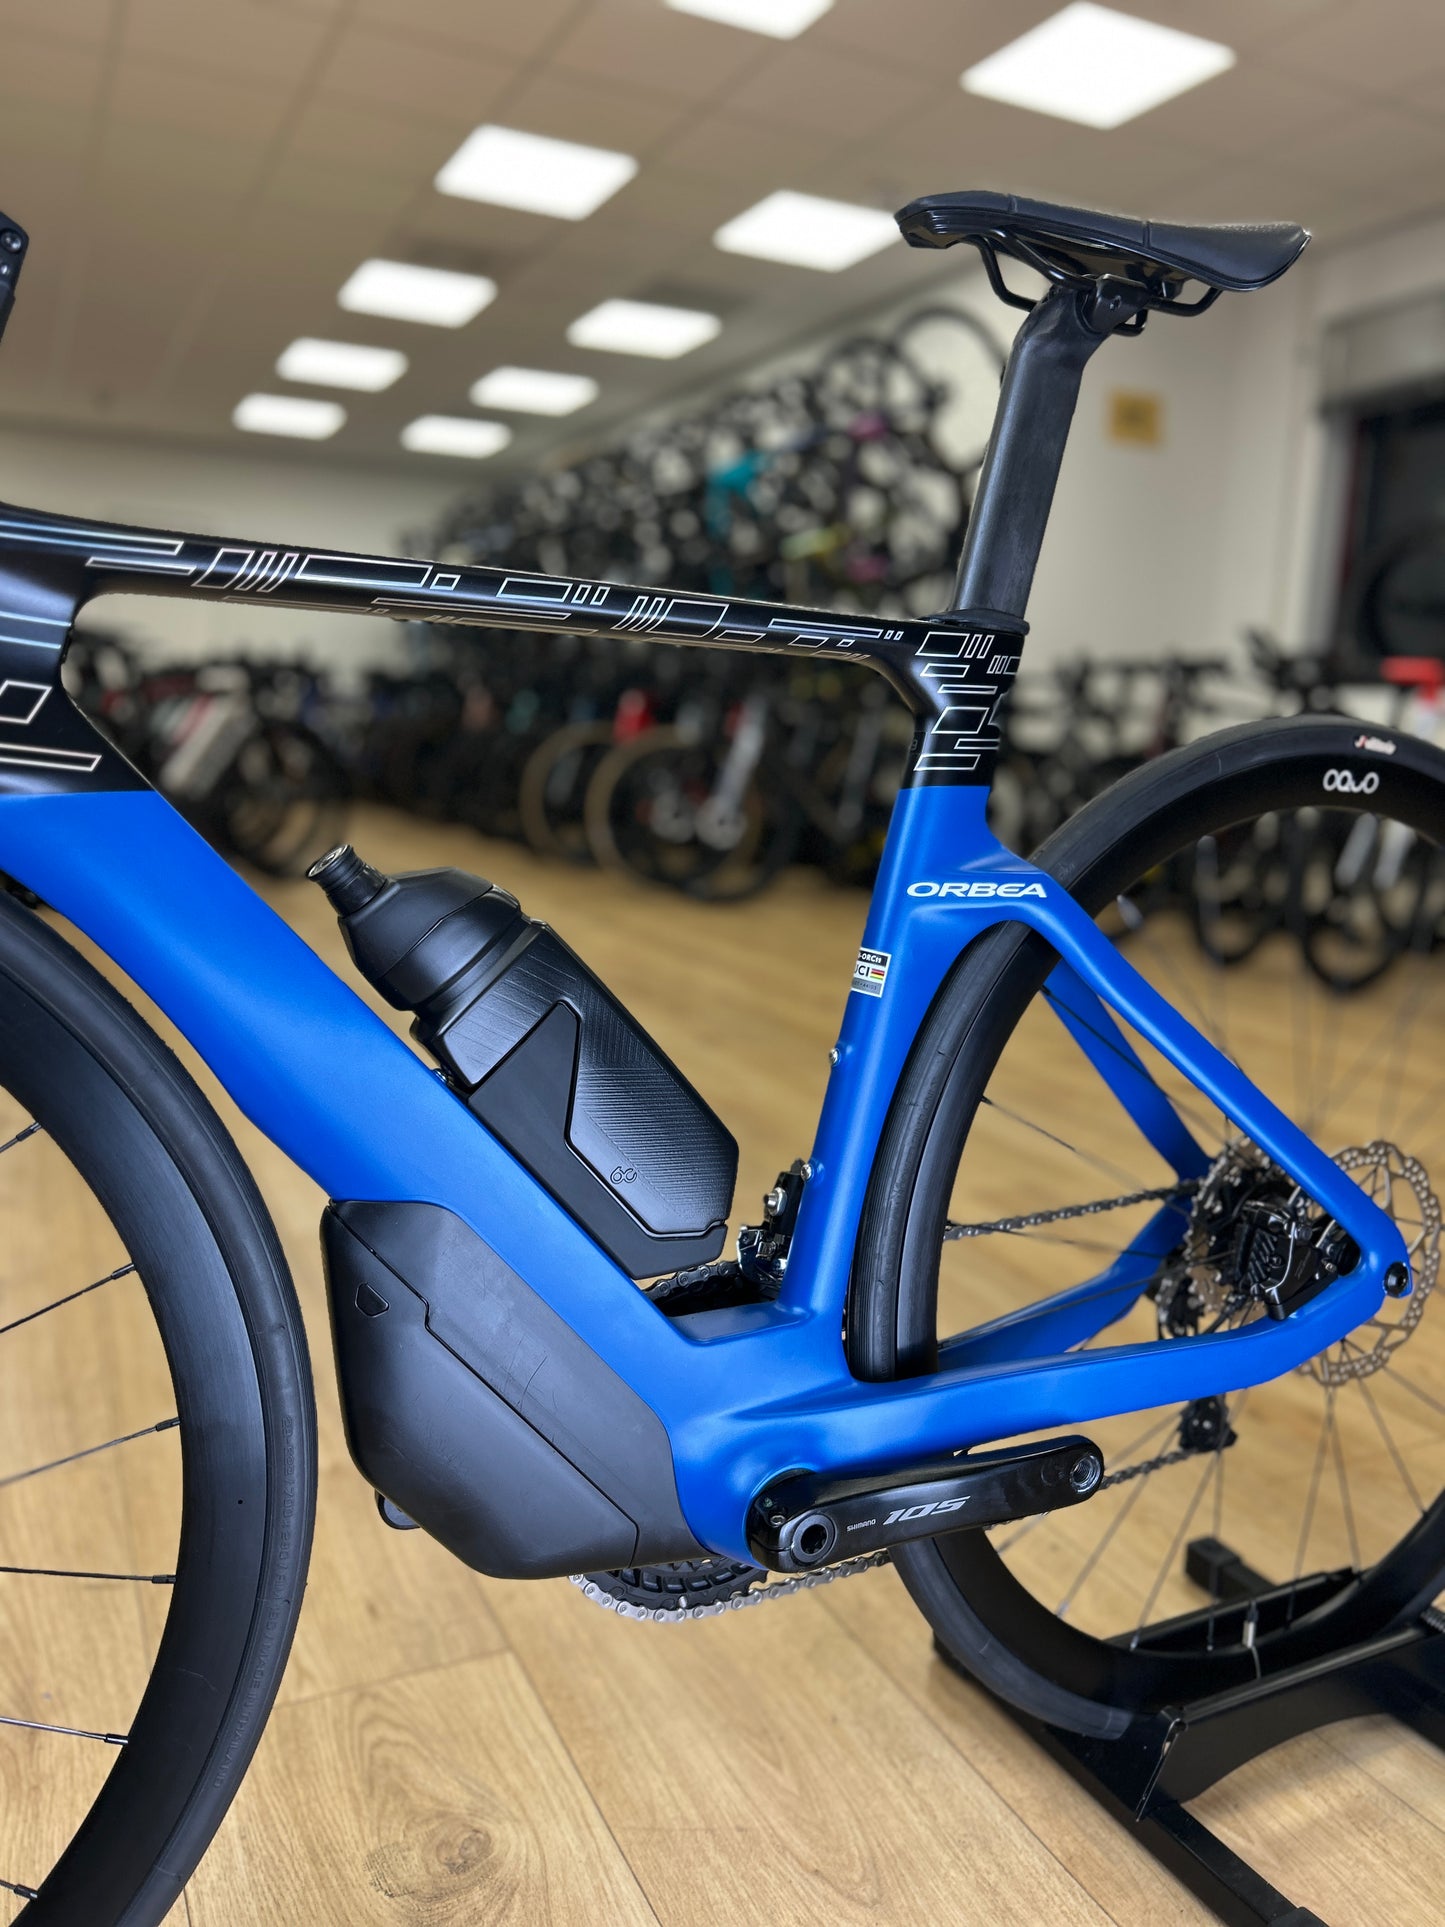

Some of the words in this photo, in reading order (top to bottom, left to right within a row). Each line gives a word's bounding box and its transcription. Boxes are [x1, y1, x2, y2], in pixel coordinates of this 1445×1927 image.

[906, 882, 1047, 898] ORBEA
[846, 1518, 877, 1532] SHIMANO
[882, 1495, 971, 1526] 105
